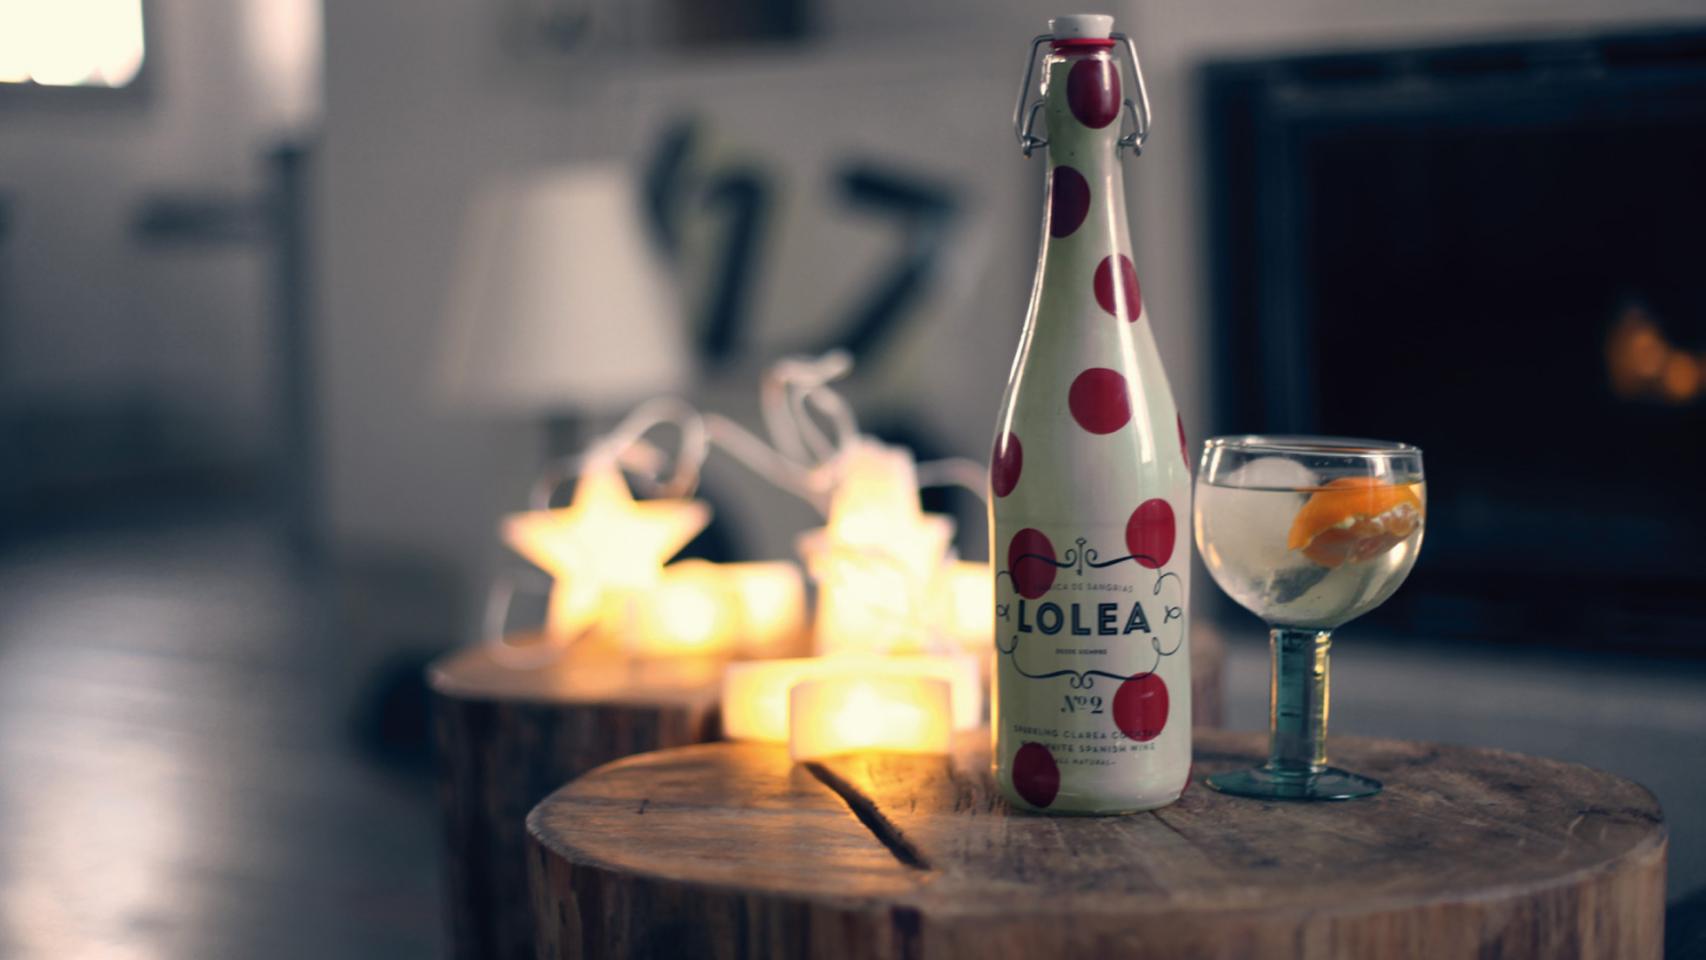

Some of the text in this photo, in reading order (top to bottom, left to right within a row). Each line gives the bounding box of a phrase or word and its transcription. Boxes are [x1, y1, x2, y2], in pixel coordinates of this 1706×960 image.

[1088, 583, 1134, 593] SANGRIAS
[1018, 600, 1151, 636] LOLEA
[1014, 724, 1058, 737] SPARKLING
[1064, 730, 1107, 739] CLAREA
[1080, 745, 1126, 754] SPANISH
